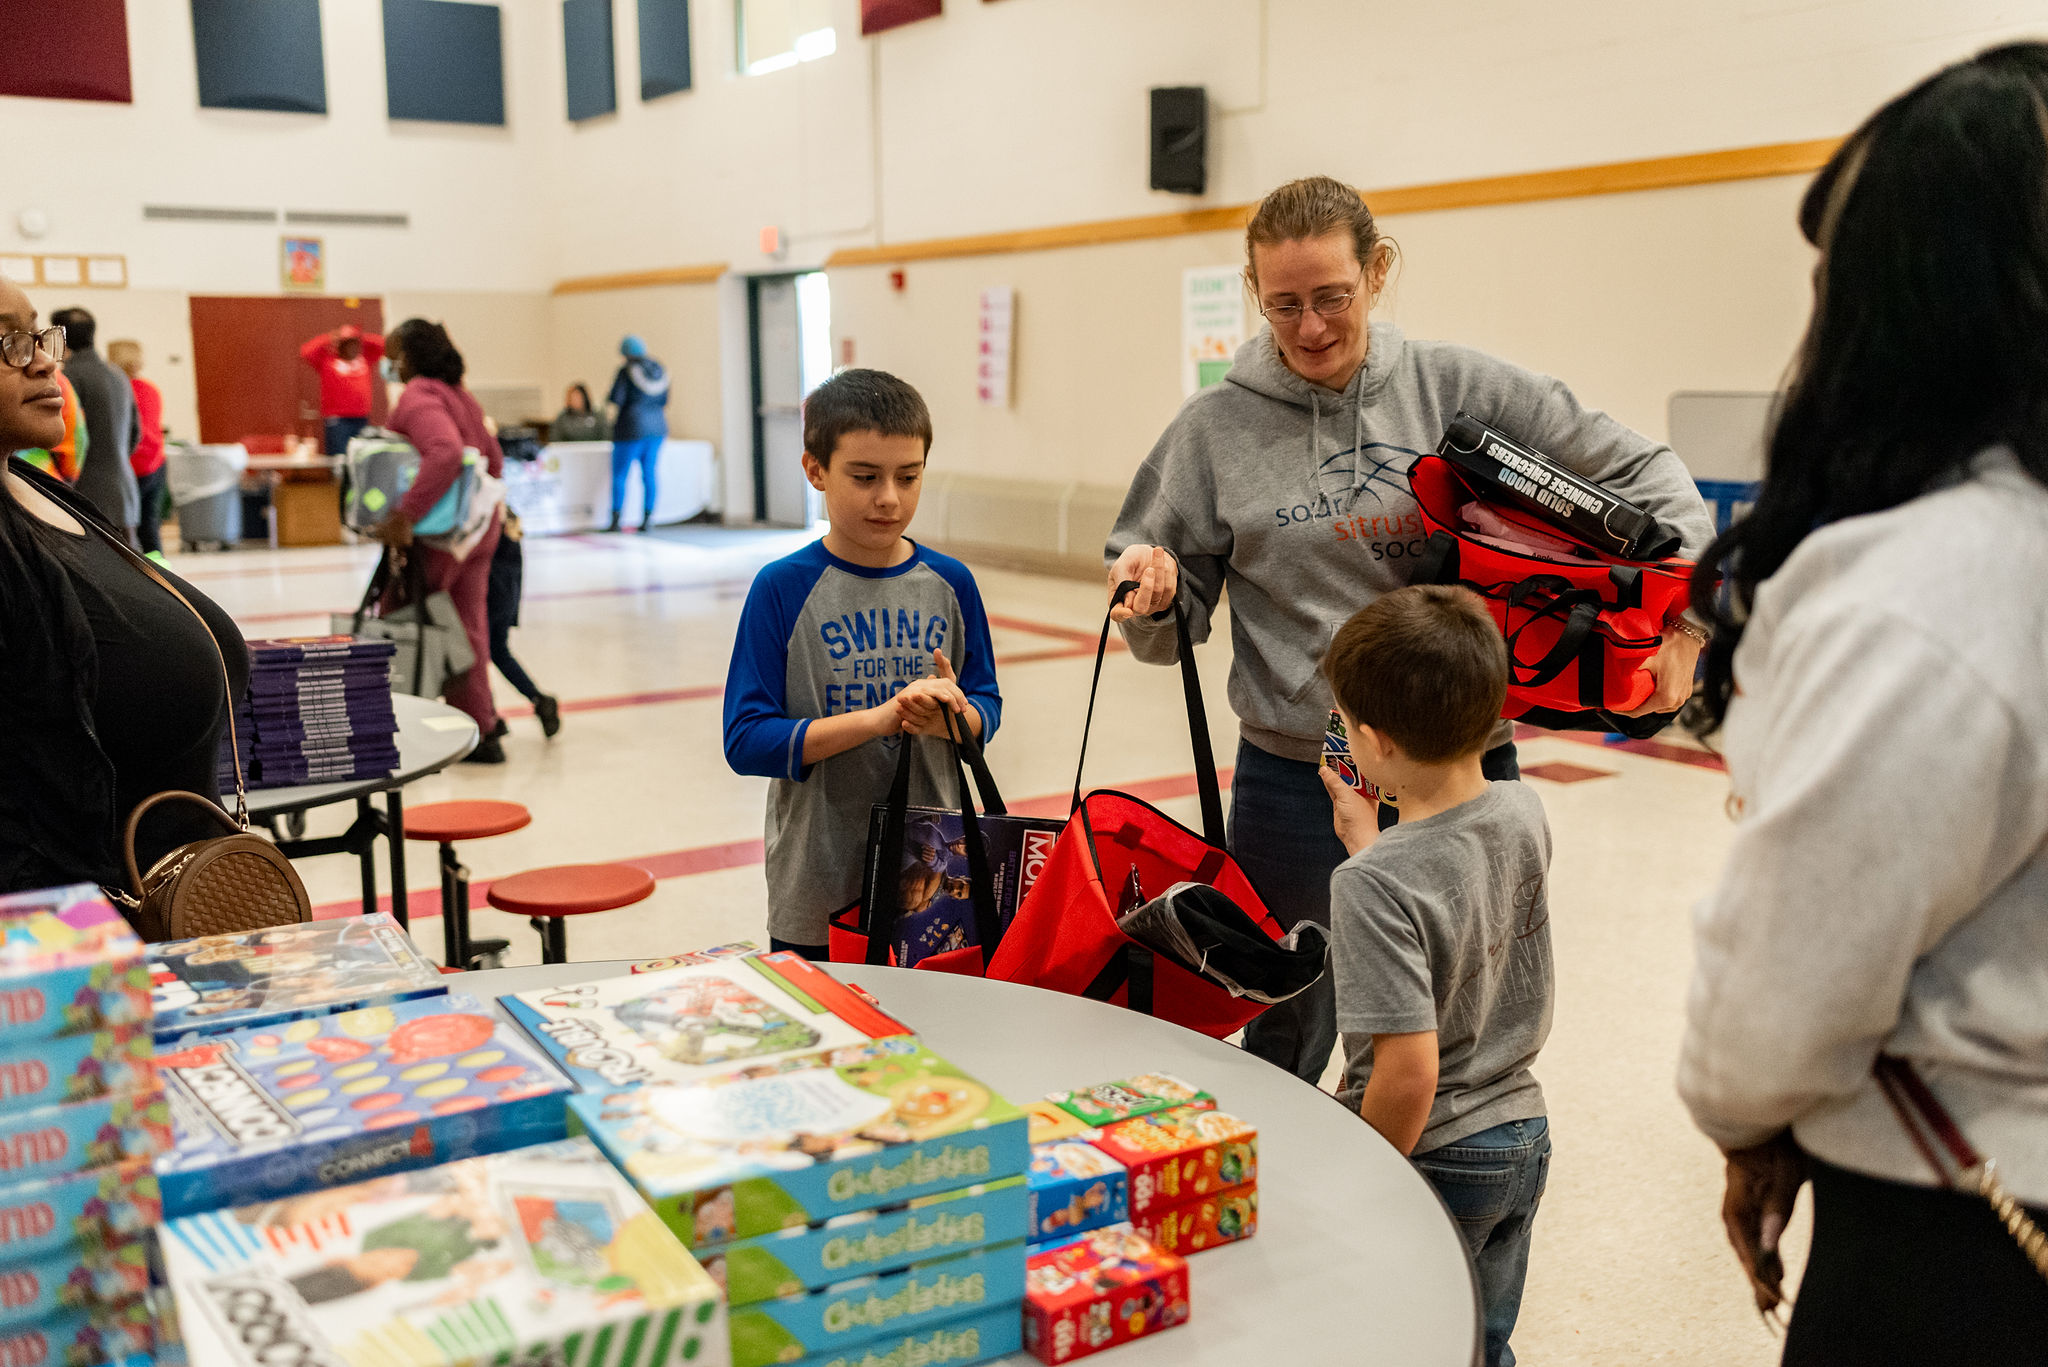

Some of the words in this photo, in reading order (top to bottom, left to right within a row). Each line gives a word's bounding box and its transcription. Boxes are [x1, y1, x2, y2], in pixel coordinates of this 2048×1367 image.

[1486, 443, 1549, 485] CHECKERS
[1498, 467, 1538, 498] WOOD
[1536, 489, 1575, 518] SOLID
[1548, 477, 1604, 514] CHINESE
[1334, 513, 1419, 541] sitrus
[820, 608, 947, 660] SWING
[854, 657, 887, 679] FOR
[892, 656, 923, 677] THE
[826, 680, 916, 717] FEN
[317, 1139, 411, 1183] CONNECT
